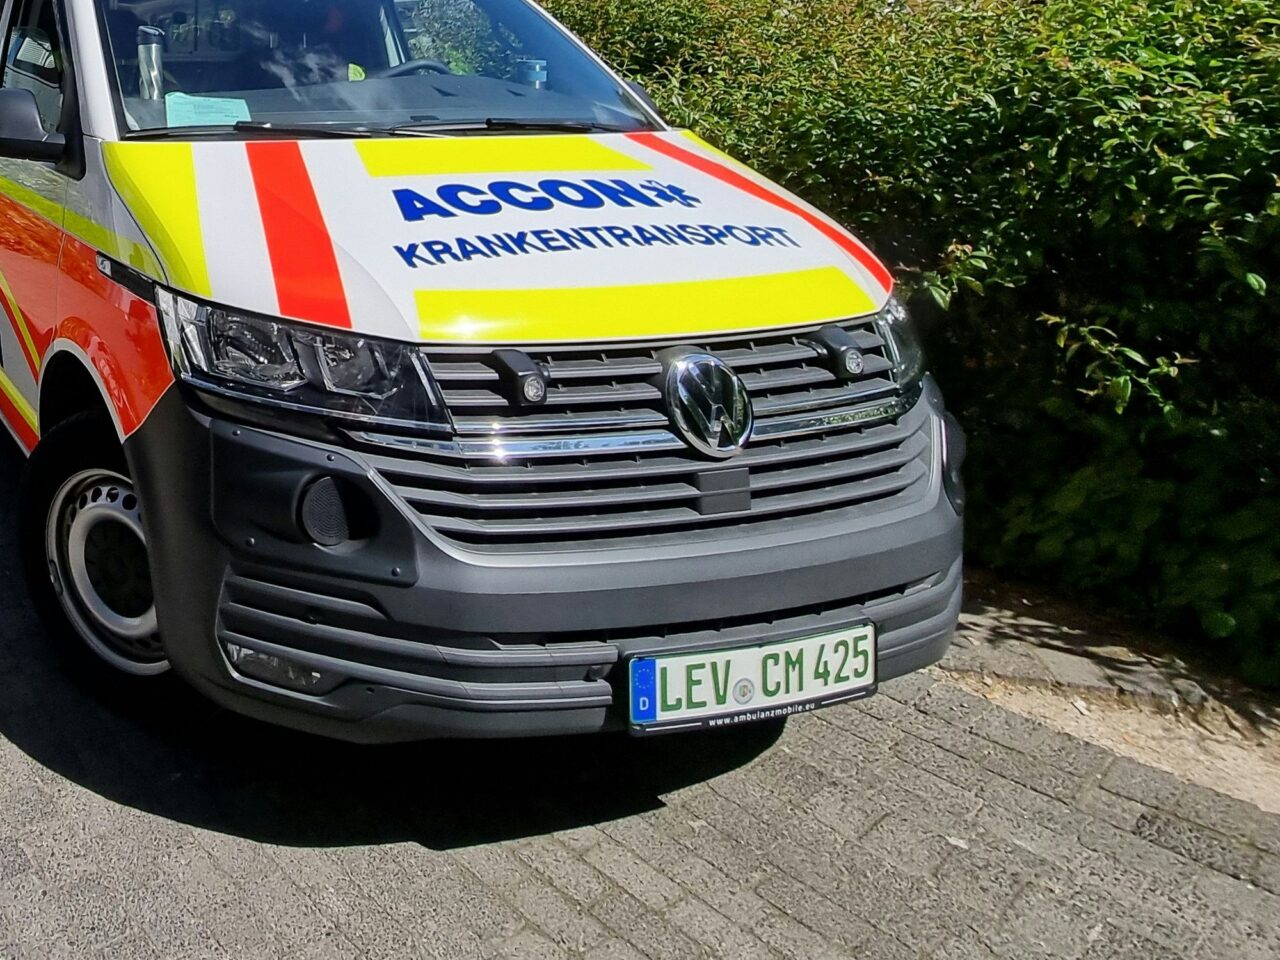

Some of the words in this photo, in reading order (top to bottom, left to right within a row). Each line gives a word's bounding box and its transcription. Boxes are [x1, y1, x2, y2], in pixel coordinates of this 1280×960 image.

[392, 178, 663, 222] ACCON
[392, 224, 802, 269] KRANKENTRANSPORT
[639, 696, 650, 711] D
[659, 659, 731, 713] LEV
[761, 647, 805, 698] CM
[813, 634, 870, 687] 425
[708, 701, 816, 727] www.ambulanzmobile.eu
